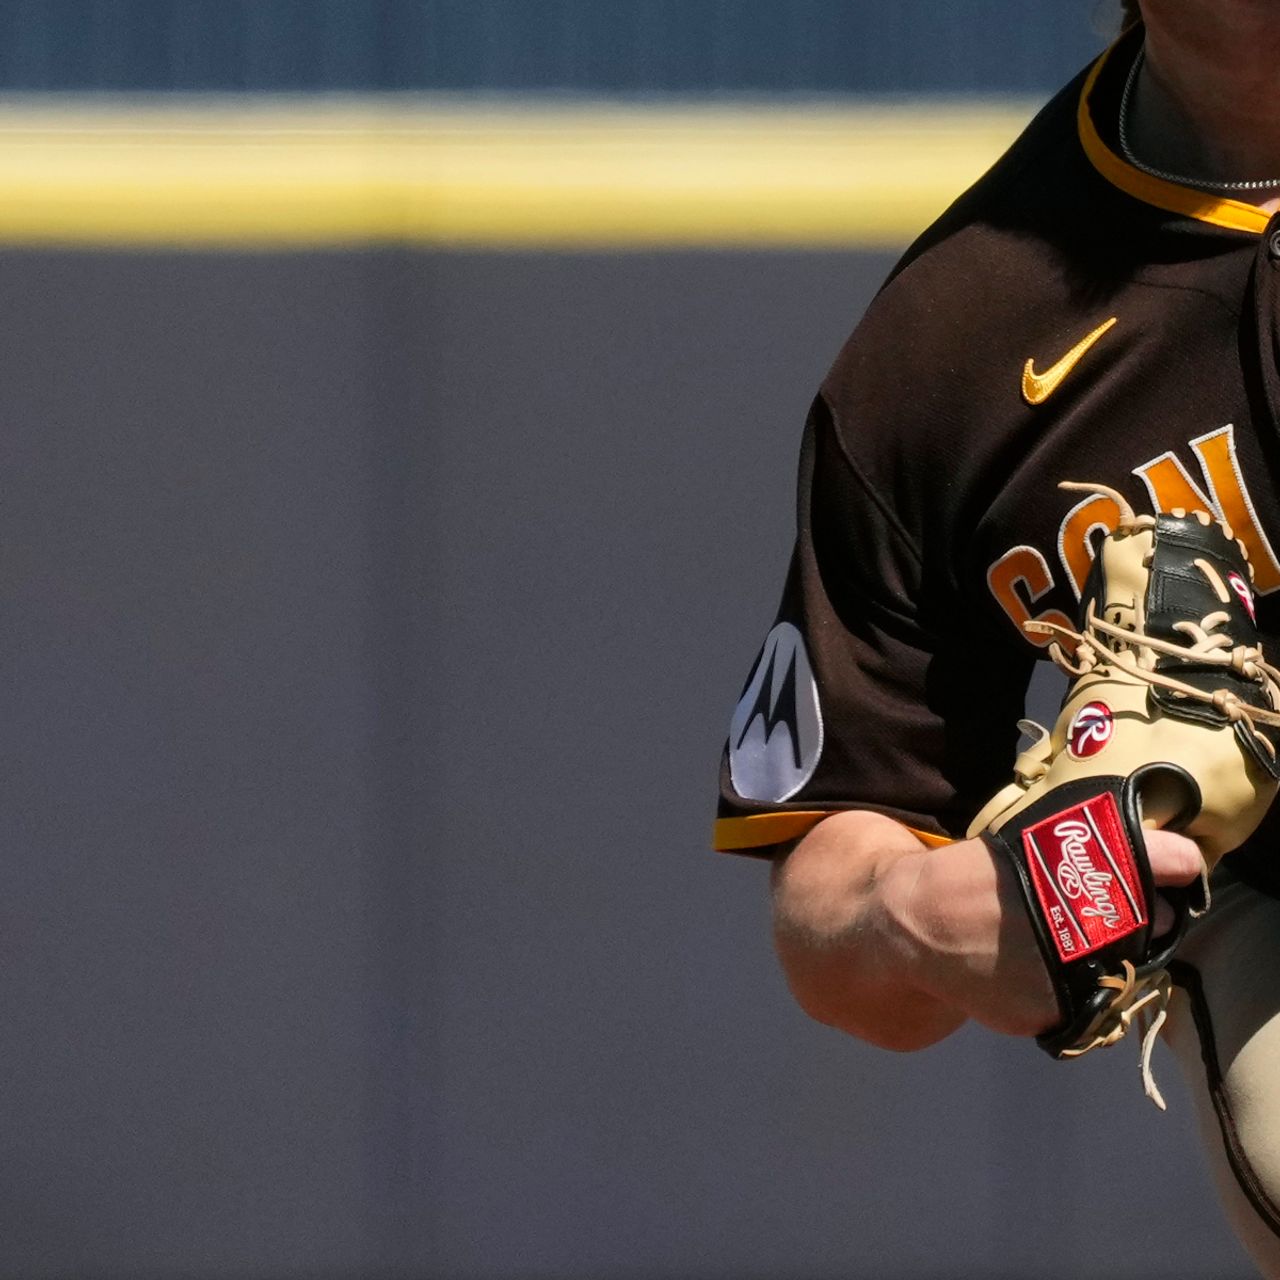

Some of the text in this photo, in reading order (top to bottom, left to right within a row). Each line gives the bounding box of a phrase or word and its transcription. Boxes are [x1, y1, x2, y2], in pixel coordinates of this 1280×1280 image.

[1053, 820, 1121, 929] Rawlings
[1049, 904, 1076, 952] Est. 1887
